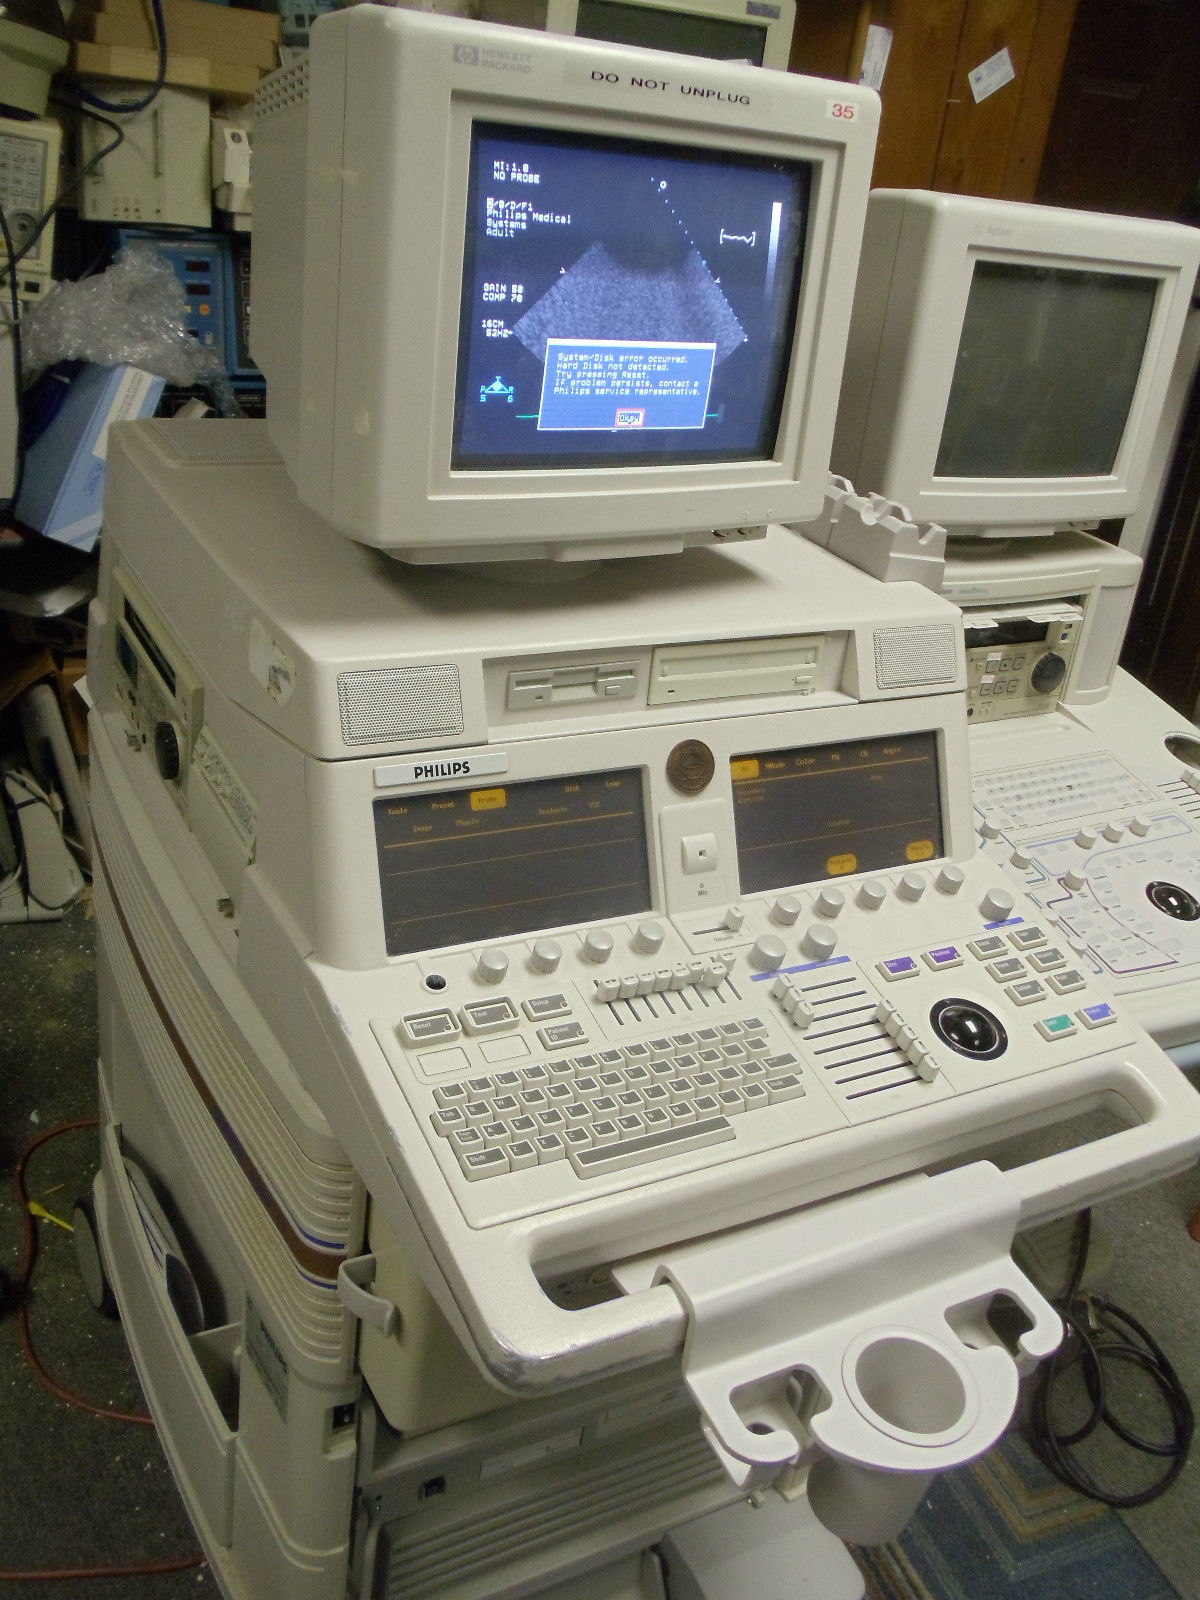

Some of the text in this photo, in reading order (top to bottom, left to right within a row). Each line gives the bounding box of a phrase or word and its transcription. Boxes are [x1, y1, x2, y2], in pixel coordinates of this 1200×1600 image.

[481, 47, 532, 61] HEWLETT
[481, 59, 532, 74] PACKARD
[591, 70, 751, 105] DO NOT UNPLUG
[831, 102, 855, 120] 35
[493, 170, 540, 184] NO PROBE
[486, 209, 571, 224] Philips Medical
[486, 218, 527, 230] Systems
[486, 227, 514, 238] Adult
[483, 282, 507, 294] GAIN
[483, 292, 506, 302] COMP
[557, 352, 688, 364] System/Disk error occurred.
[556, 362, 670, 371] Hard Disk not detected.
[555, 370, 649, 380] Try pressing Reset.
[554, 378, 565, 386] If
[570, 378, 607, 387] problem
[658, 379, 690, 388] contact
[553, 387, 700, 396] Philips service representative.
[414, 760, 471, 779] PHILIPS
[469, 1155, 486, 1163] Shift
